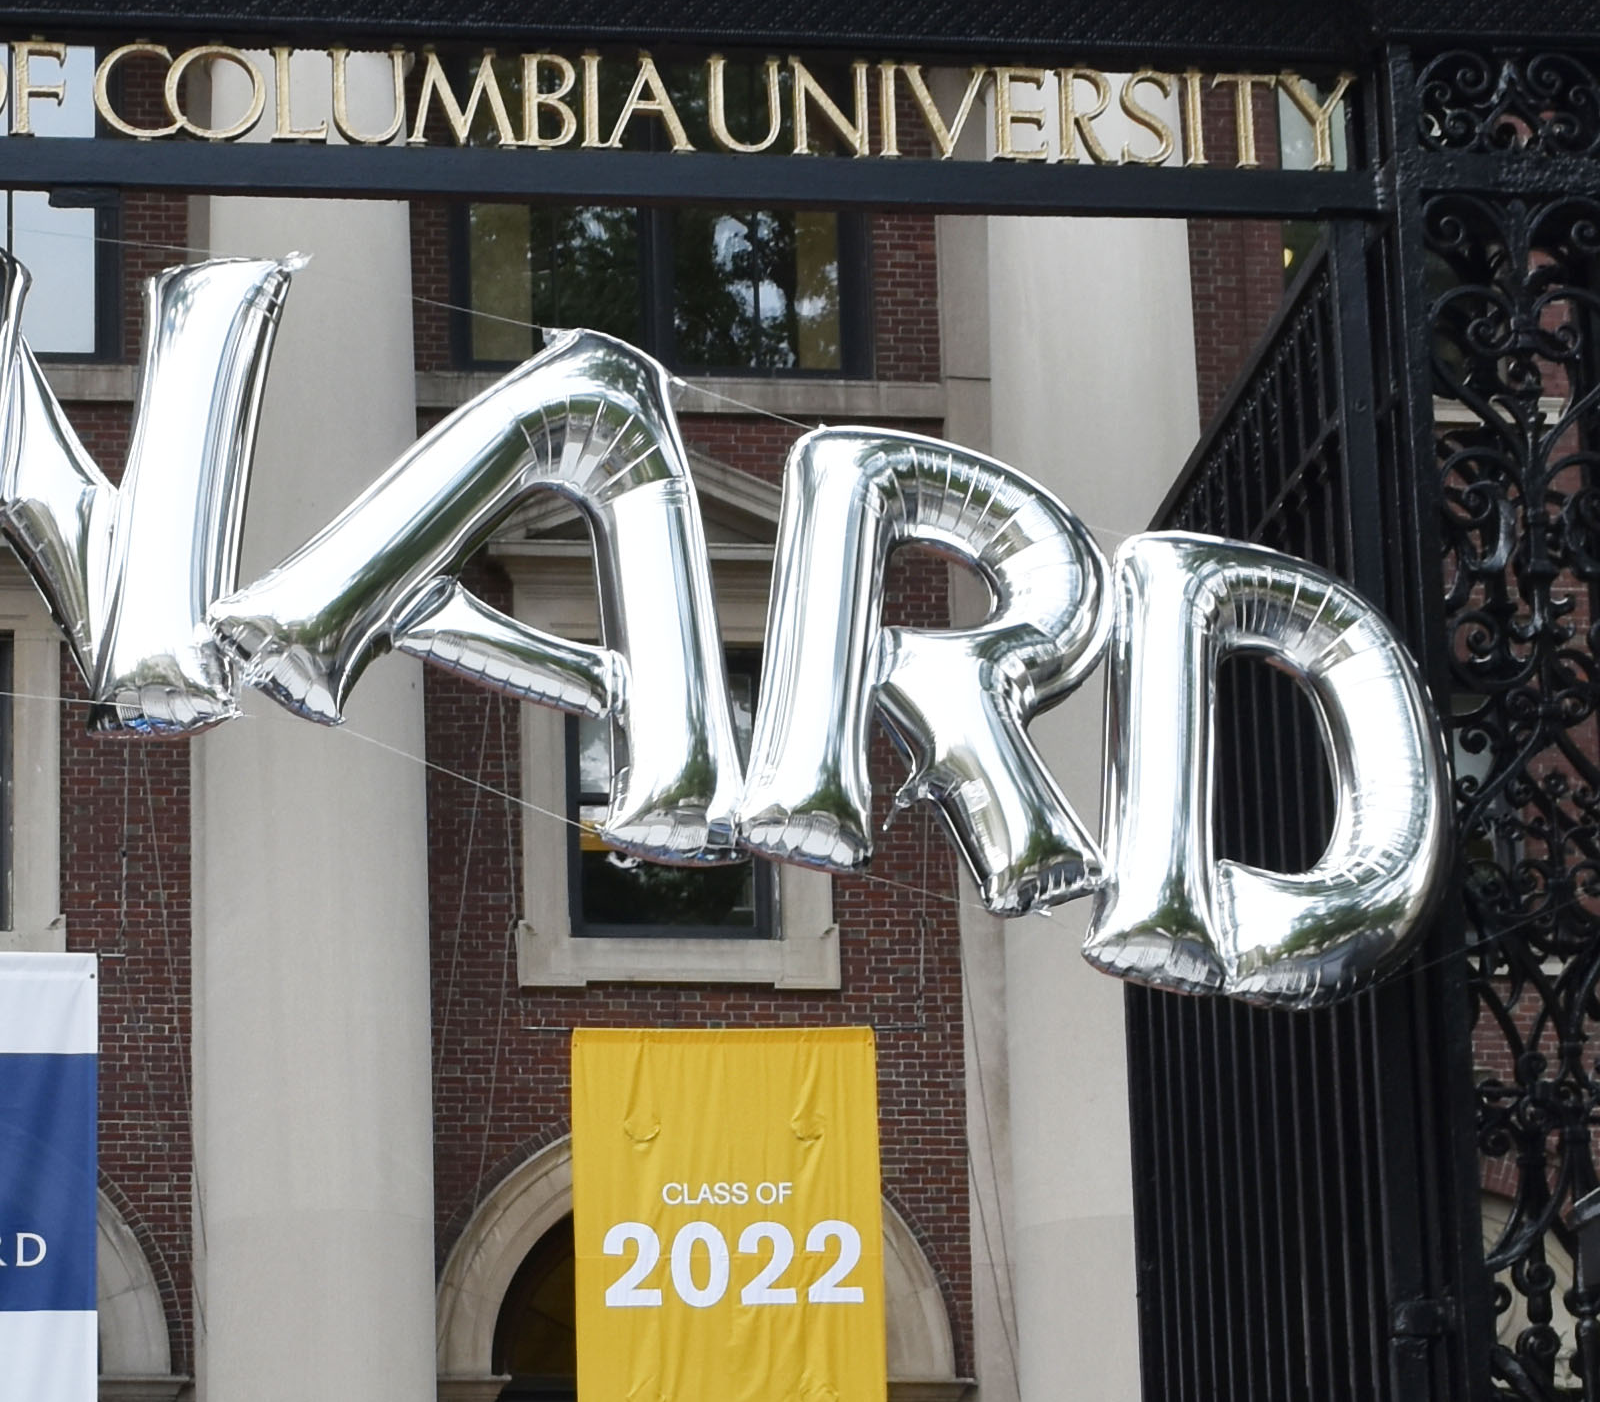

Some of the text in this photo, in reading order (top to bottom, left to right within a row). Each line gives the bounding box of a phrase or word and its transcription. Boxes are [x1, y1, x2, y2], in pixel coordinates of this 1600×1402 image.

[93, 43, 697, 153] COLUMBIA
[707, 56, 1357, 170] UNIVERSITY
[662, 1182, 793, 1205] CLASS OF
[602, 1219, 865, 1309] 2022
